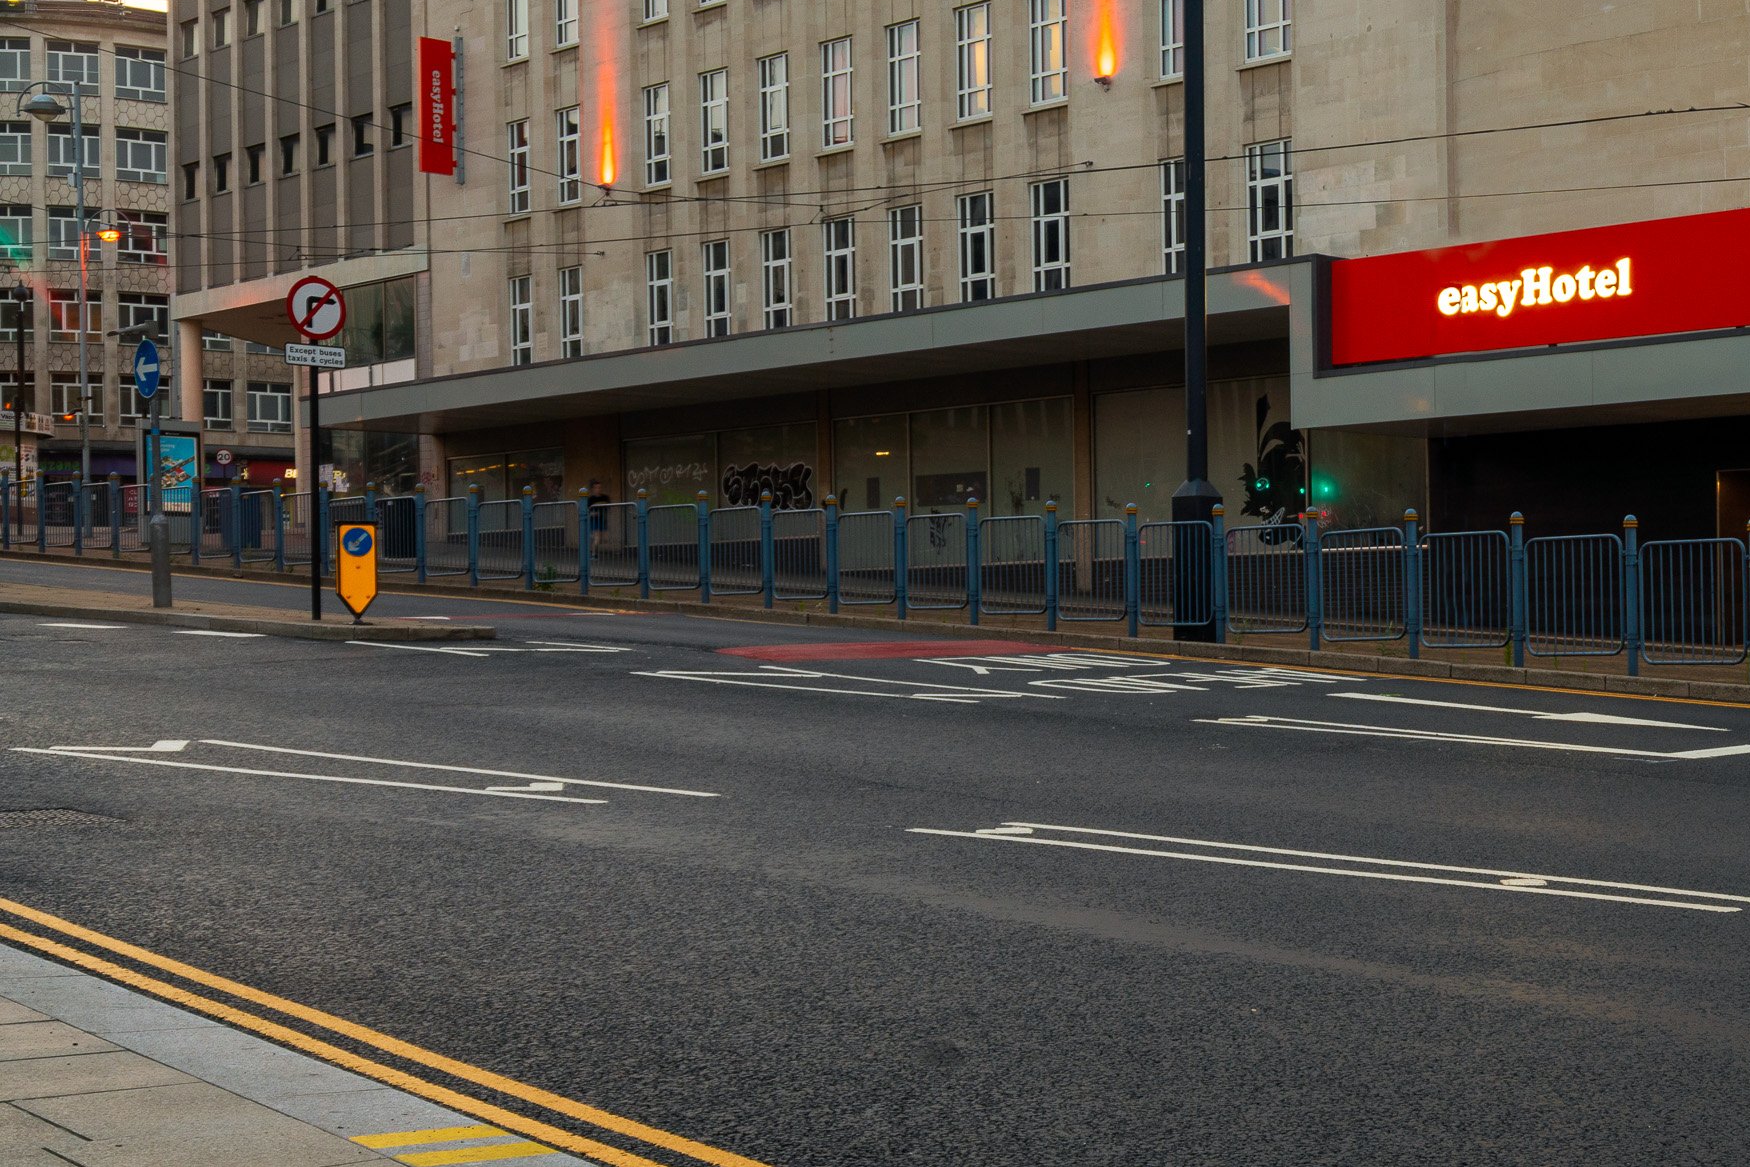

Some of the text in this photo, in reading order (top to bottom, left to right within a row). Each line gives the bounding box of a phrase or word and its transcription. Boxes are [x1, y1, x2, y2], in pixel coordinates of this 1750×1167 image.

[430, 70, 444, 143] easyHotel
[1437, 257, 1633, 317] easyHotel
[288, 355, 308, 363] taxis
[319, 357, 343, 366] cycles
[289, 346, 342, 357] Except buses
[217, 453, 230, 461] 20
[912, 653, 1172, 675] ONLY
[1027, 668, 1368, 694] AHEAD
